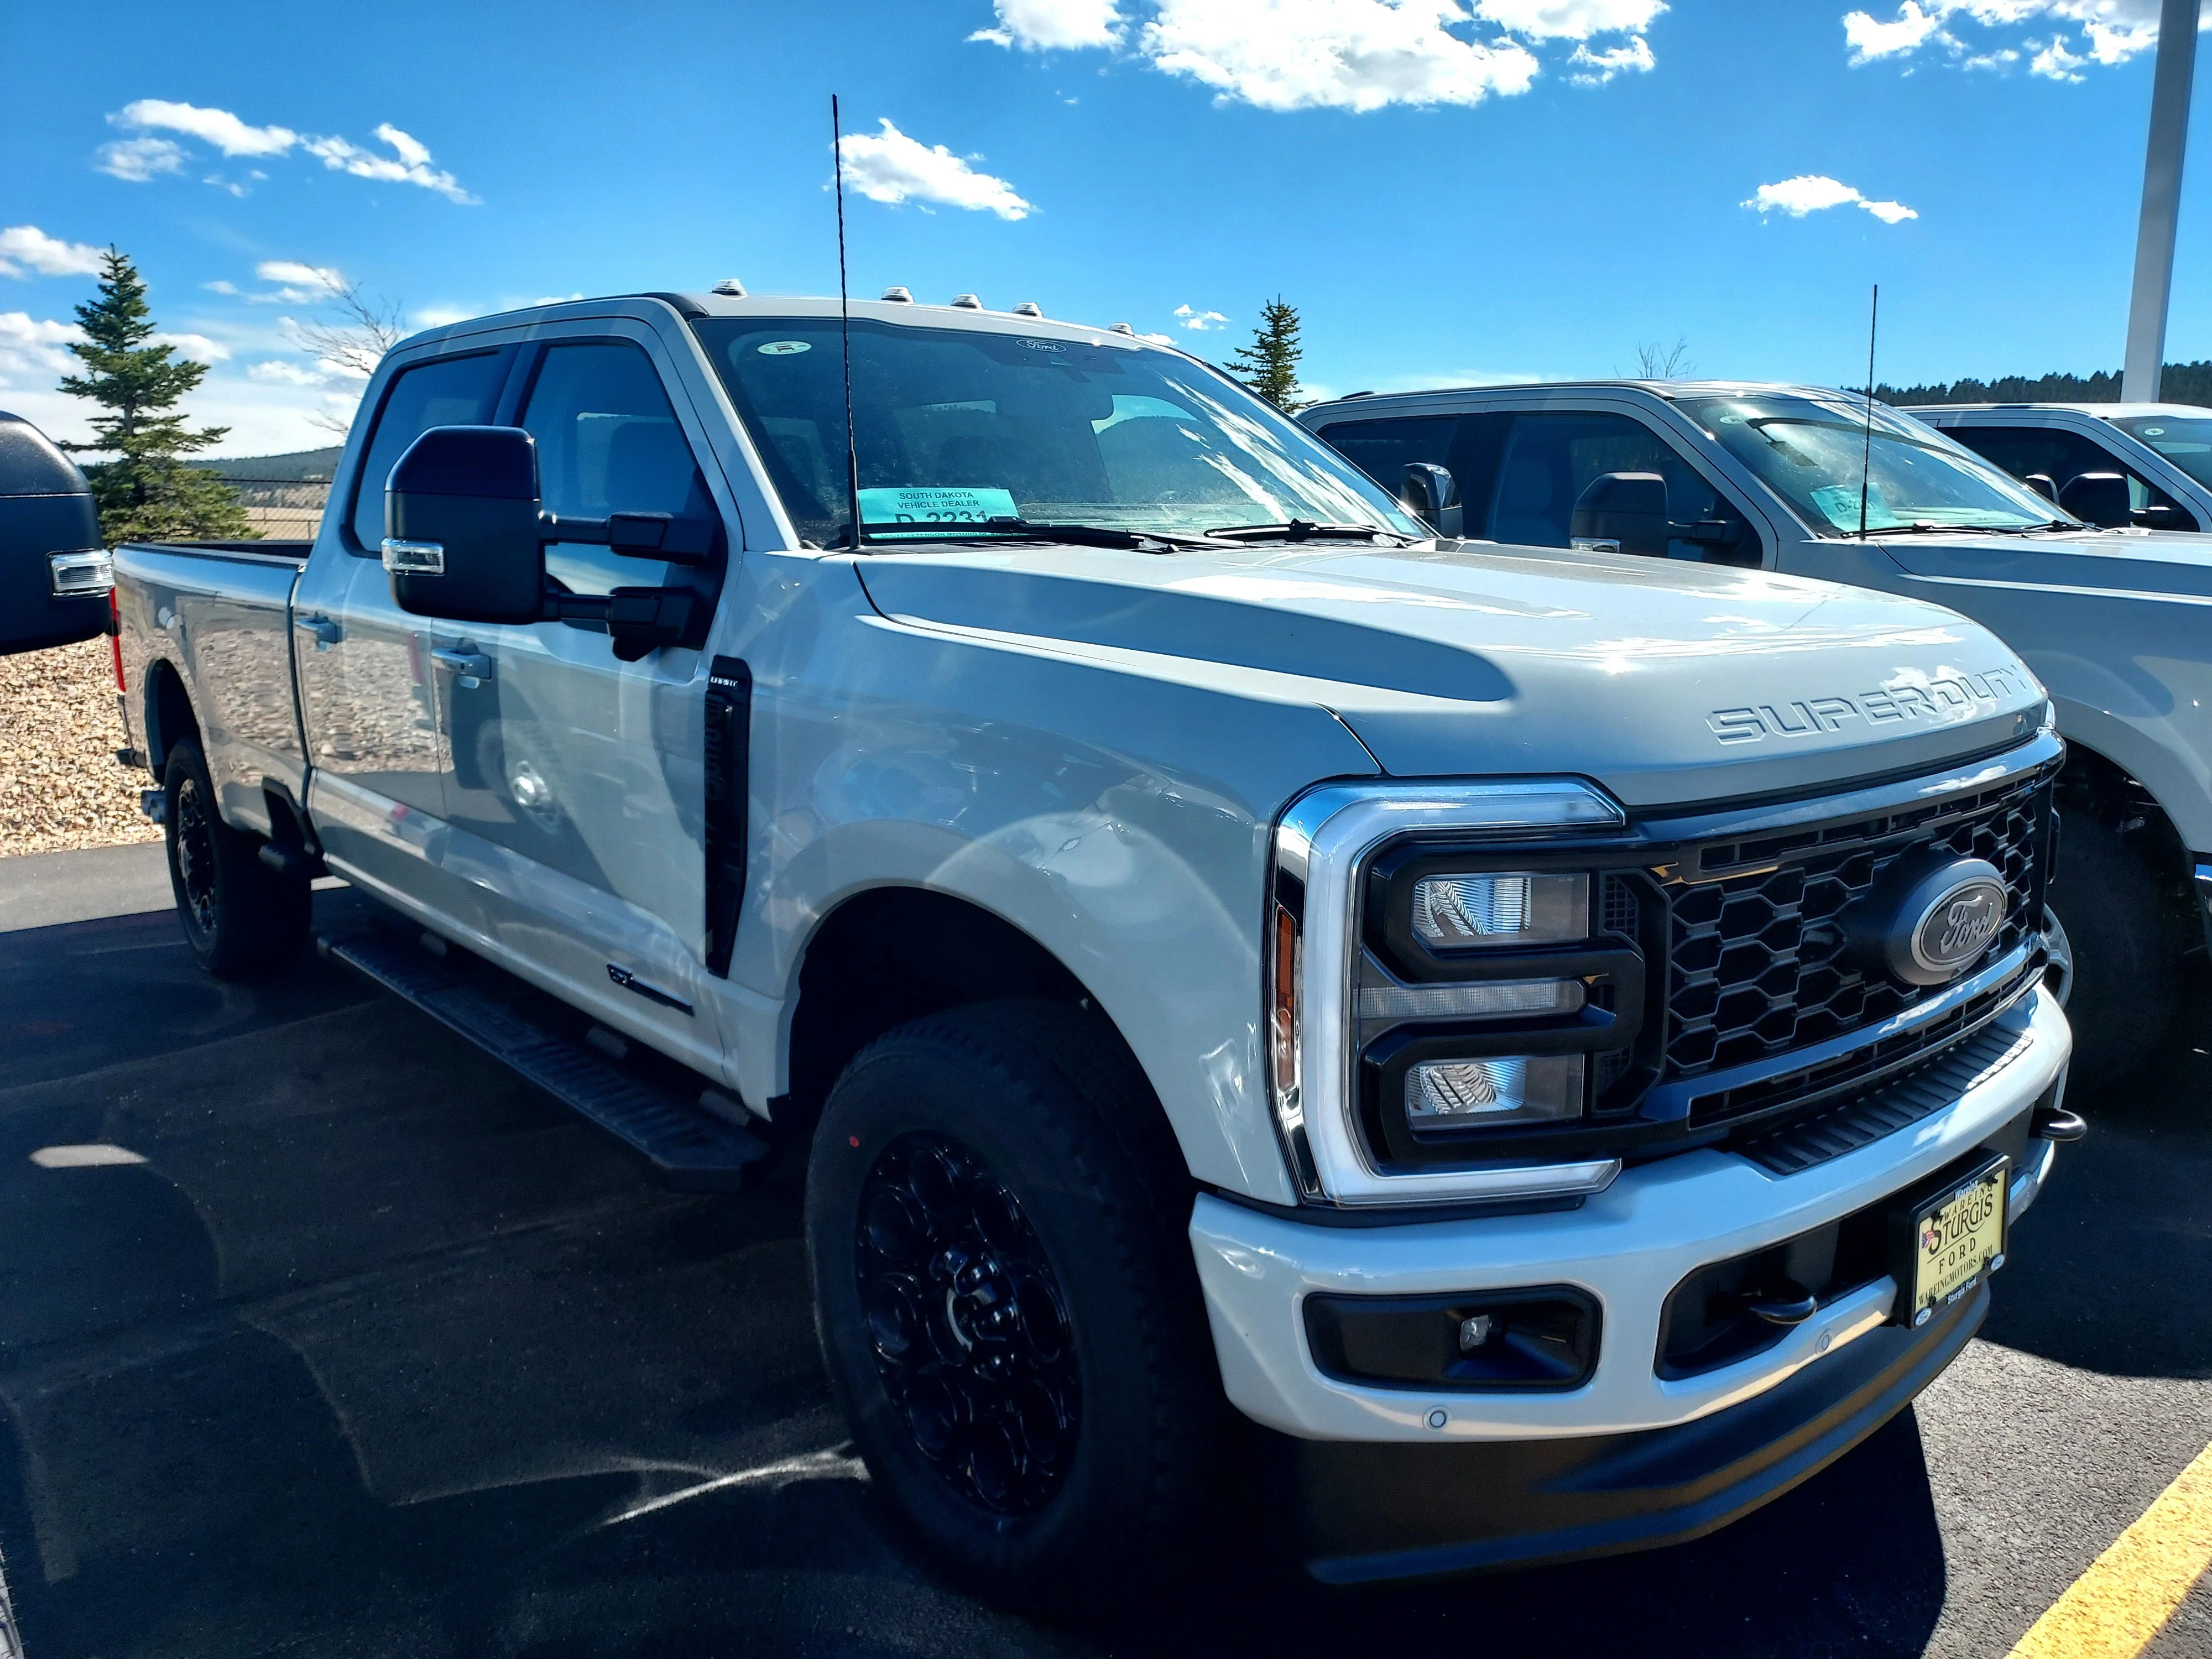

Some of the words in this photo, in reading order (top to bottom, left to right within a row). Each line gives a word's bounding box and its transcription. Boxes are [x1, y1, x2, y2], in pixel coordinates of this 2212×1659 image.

[1026, 340, 1058, 351] Ford
[1939, 894, 1994, 954] Ford
[1944, 1183, 1992, 1221] WAREING
[1928, 1193, 1993, 1255] STURGIS
[1918, 1244, 1993, 1306] WAREINGMOTORS.COM
[1938, 1237, 1976, 1275] FORD
[1965, 1276, 1977, 1292] Ford
